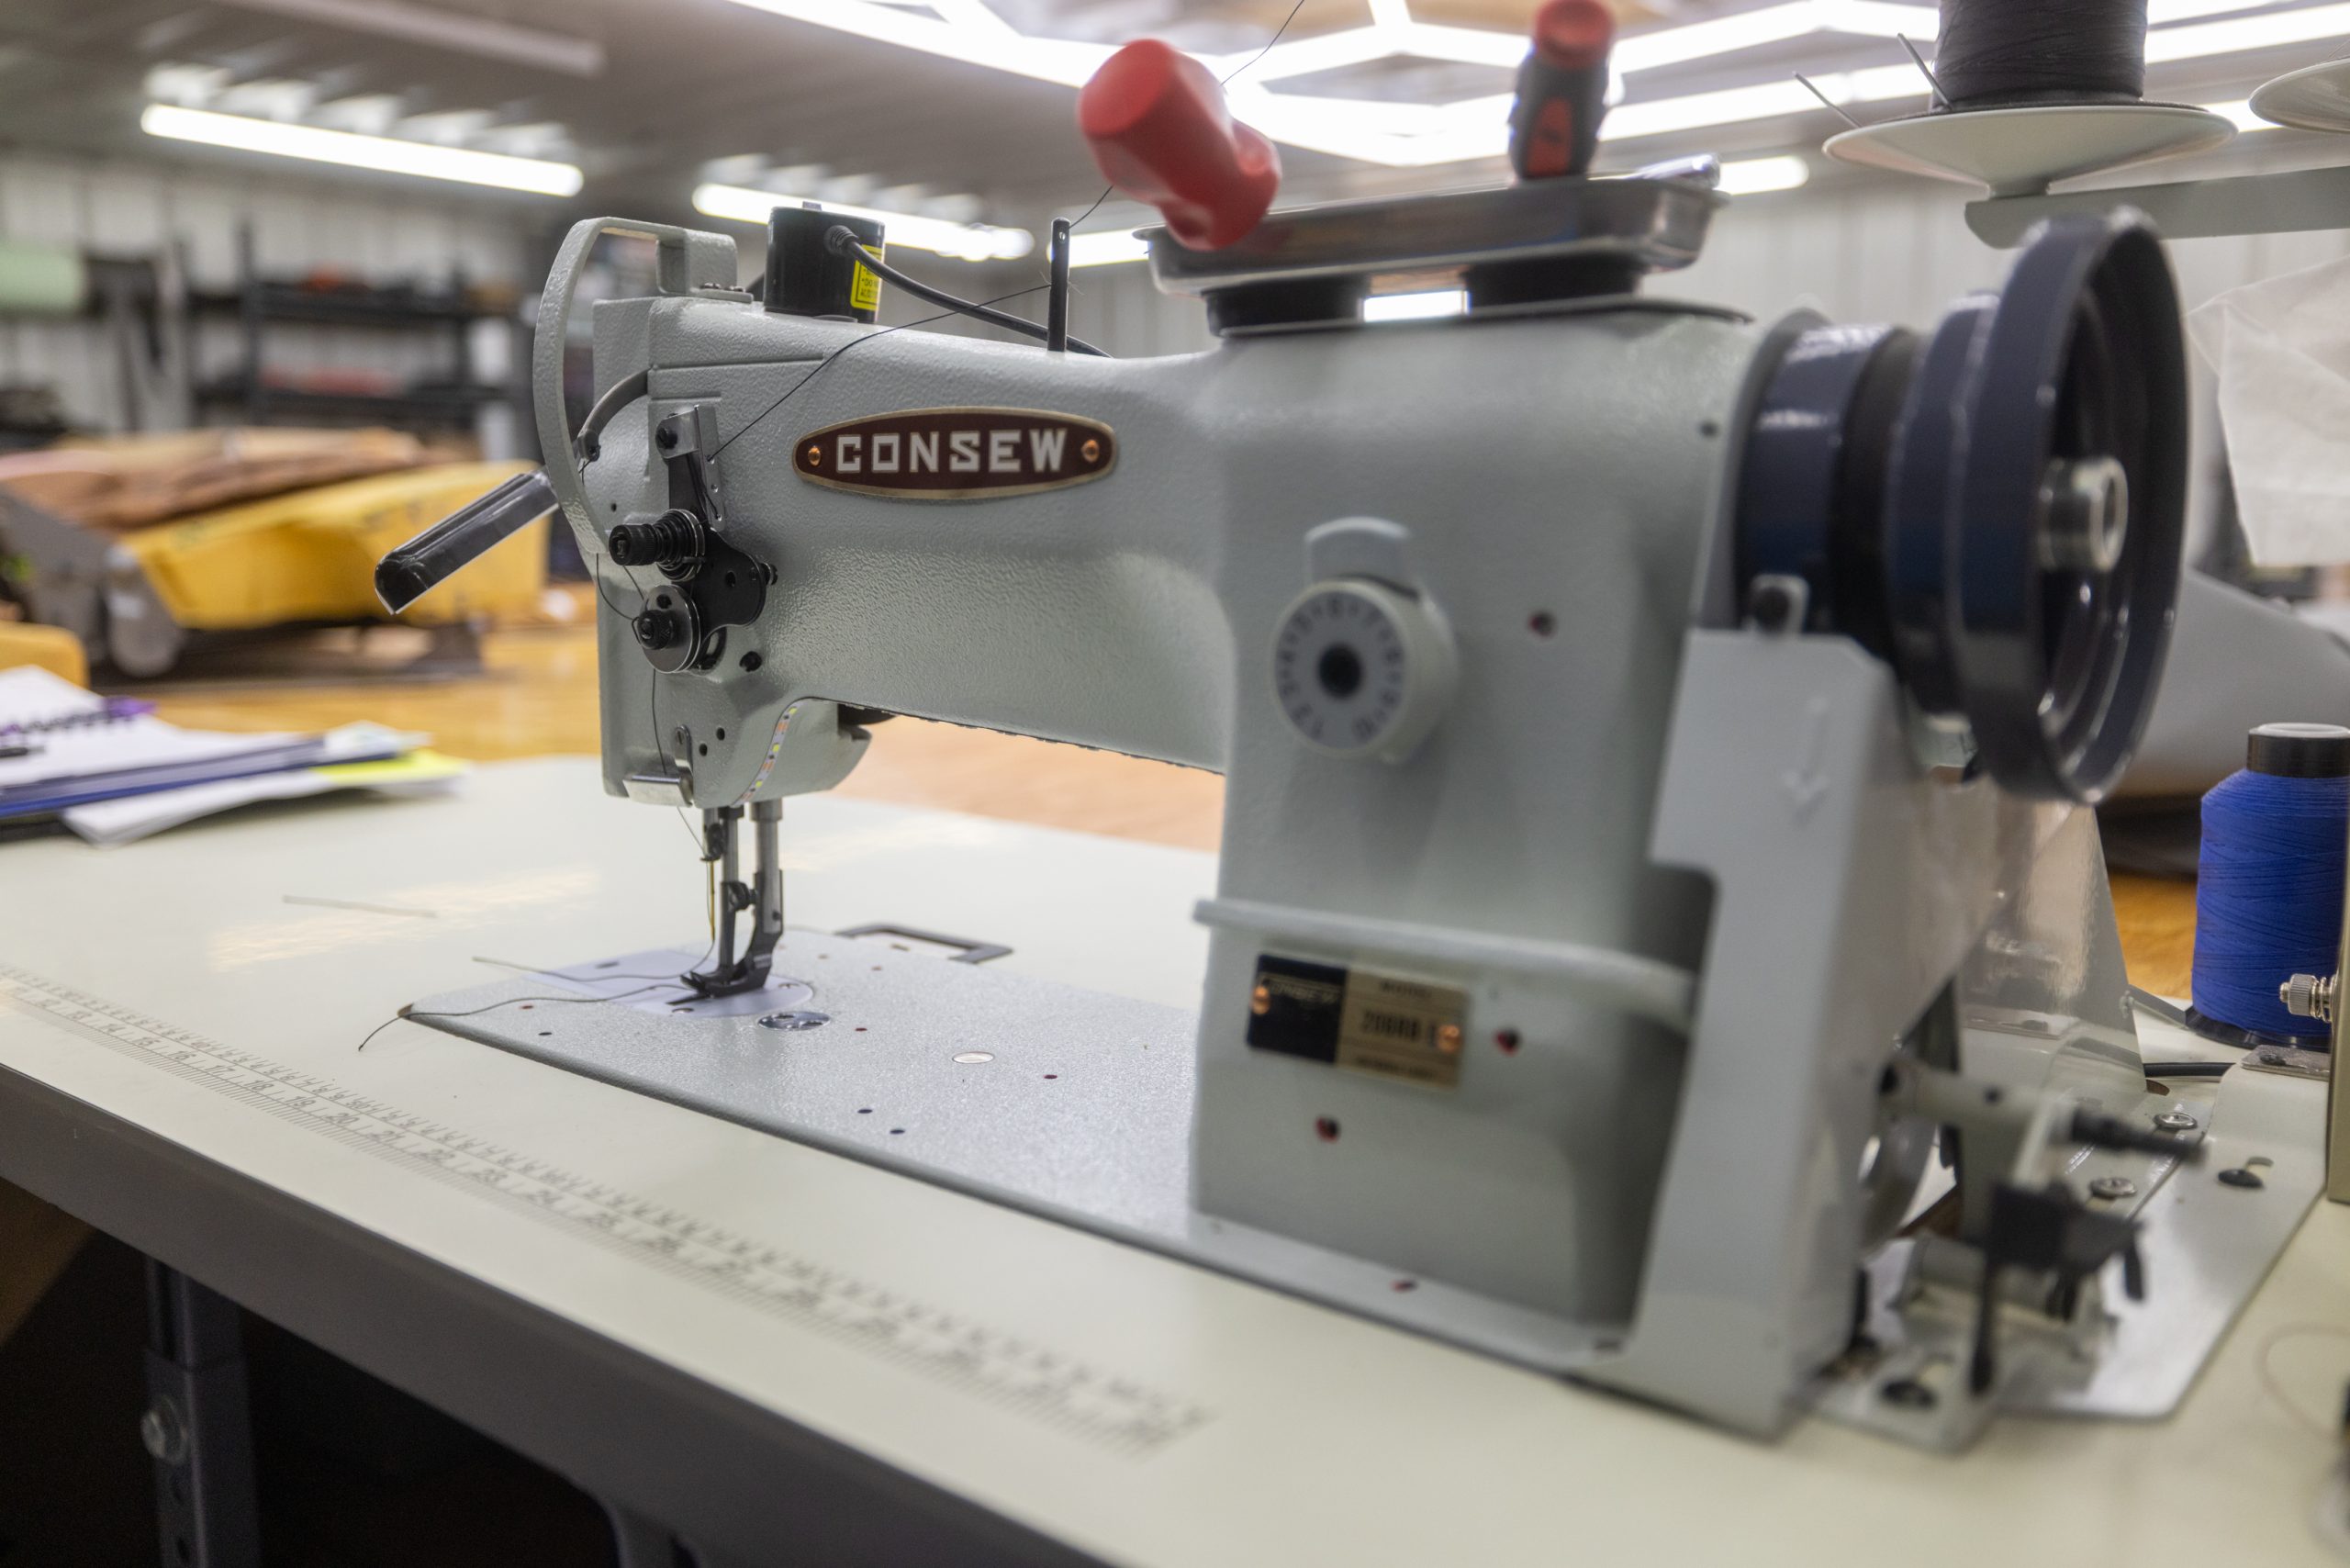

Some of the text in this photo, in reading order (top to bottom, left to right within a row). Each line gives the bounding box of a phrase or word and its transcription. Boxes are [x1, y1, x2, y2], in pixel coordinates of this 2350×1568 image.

[836, 429, 1068, 474] CONSEW
[167, 1049, 197, 1061] 16
[204, 1064, 237, 1075] 17
[243, 1080, 275, 1092] 18
[284, 1095, 317, 1110] 19
[320, 1112, 361, 1126] 20
[367, 1130, 407, 1143] 21
